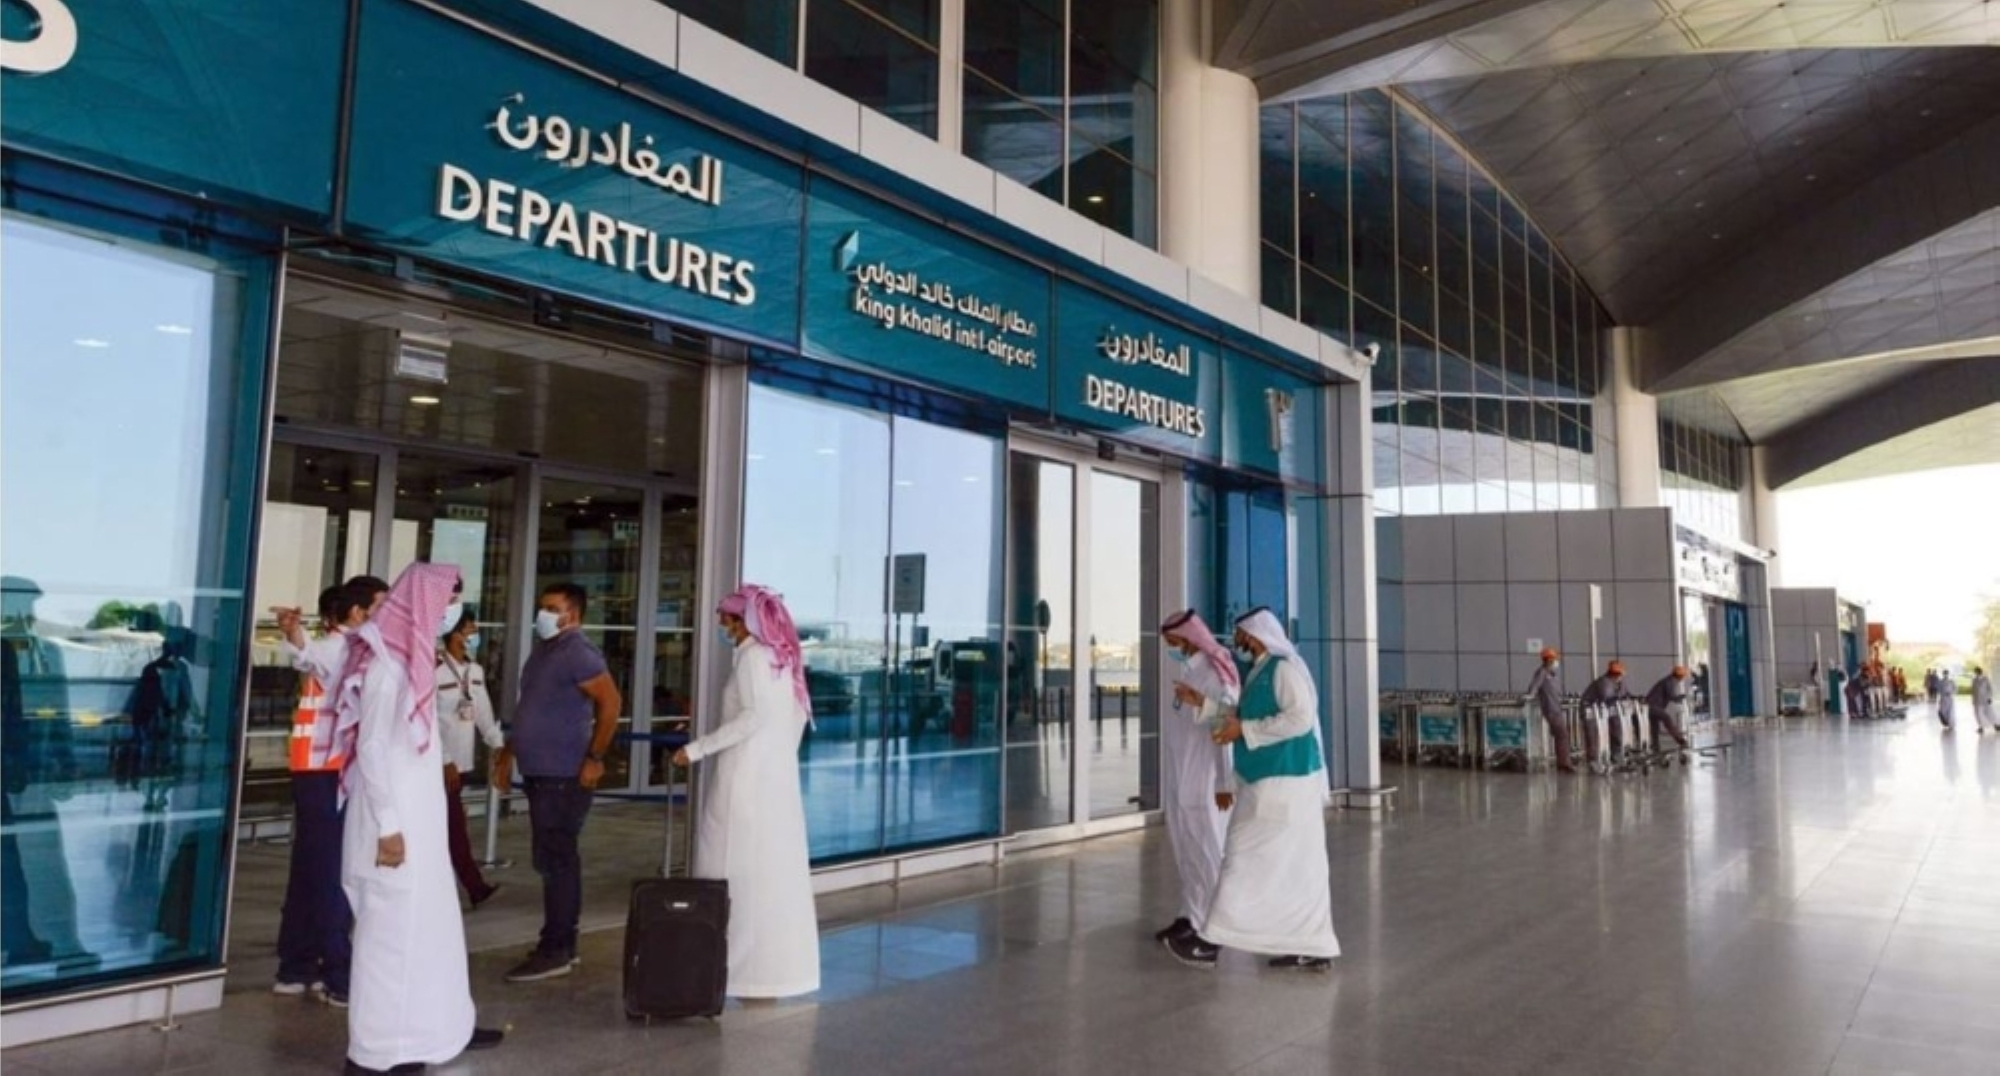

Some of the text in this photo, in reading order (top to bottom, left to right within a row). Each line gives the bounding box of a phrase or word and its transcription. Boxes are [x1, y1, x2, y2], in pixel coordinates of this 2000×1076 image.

[496, 92, 722, 206] المغادرون
[438, 164, 757, 306] DEPARTURES
[855, 286, 895, 330] king
[900, 302, 951, 341] khalid
[987, 334, 1037, 370] airport
[856, 262, 1037, 337] مطار الملك خالد الدولي
[1104, 325, 1190, 377] المغادرون
[1086, 373, 1206, 438] DEPARTURES
